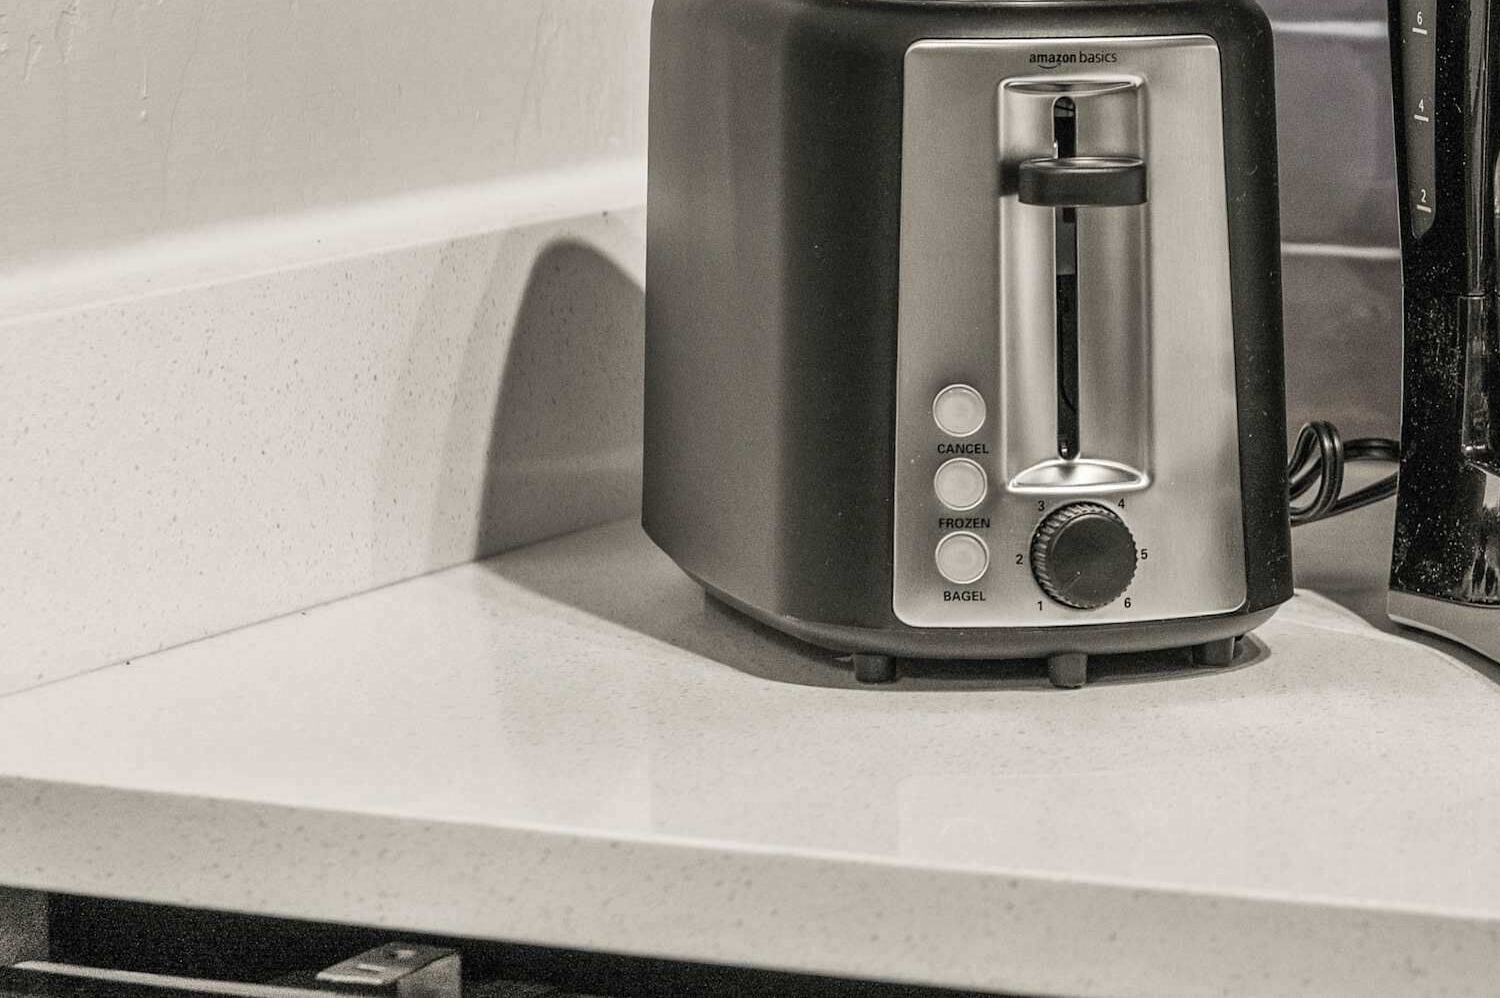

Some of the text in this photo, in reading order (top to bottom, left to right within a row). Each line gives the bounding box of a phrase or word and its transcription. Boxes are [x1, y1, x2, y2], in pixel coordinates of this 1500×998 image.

[1416, 10, 1423, 26] 6
[1029, 50, 1117, 65] amazon basics
[1418, 97, 1425, 113] 4
[1420, 188, 1427, 204] 2
[937, 443, 989, 455] CANCEL
[1037, 500, 1045, 512] 3
[1117, 498, 1126, 510] 4
[938, 517, 990, 528] FROZEN
[1016, 553, 1024, 565] 2
[1140, 548, 1149, 560] 5
[943, 590, 987, 602] BAGEL
[1037, 600, 1044, 612] 1
[1123, 597, 1132, 609] 6
